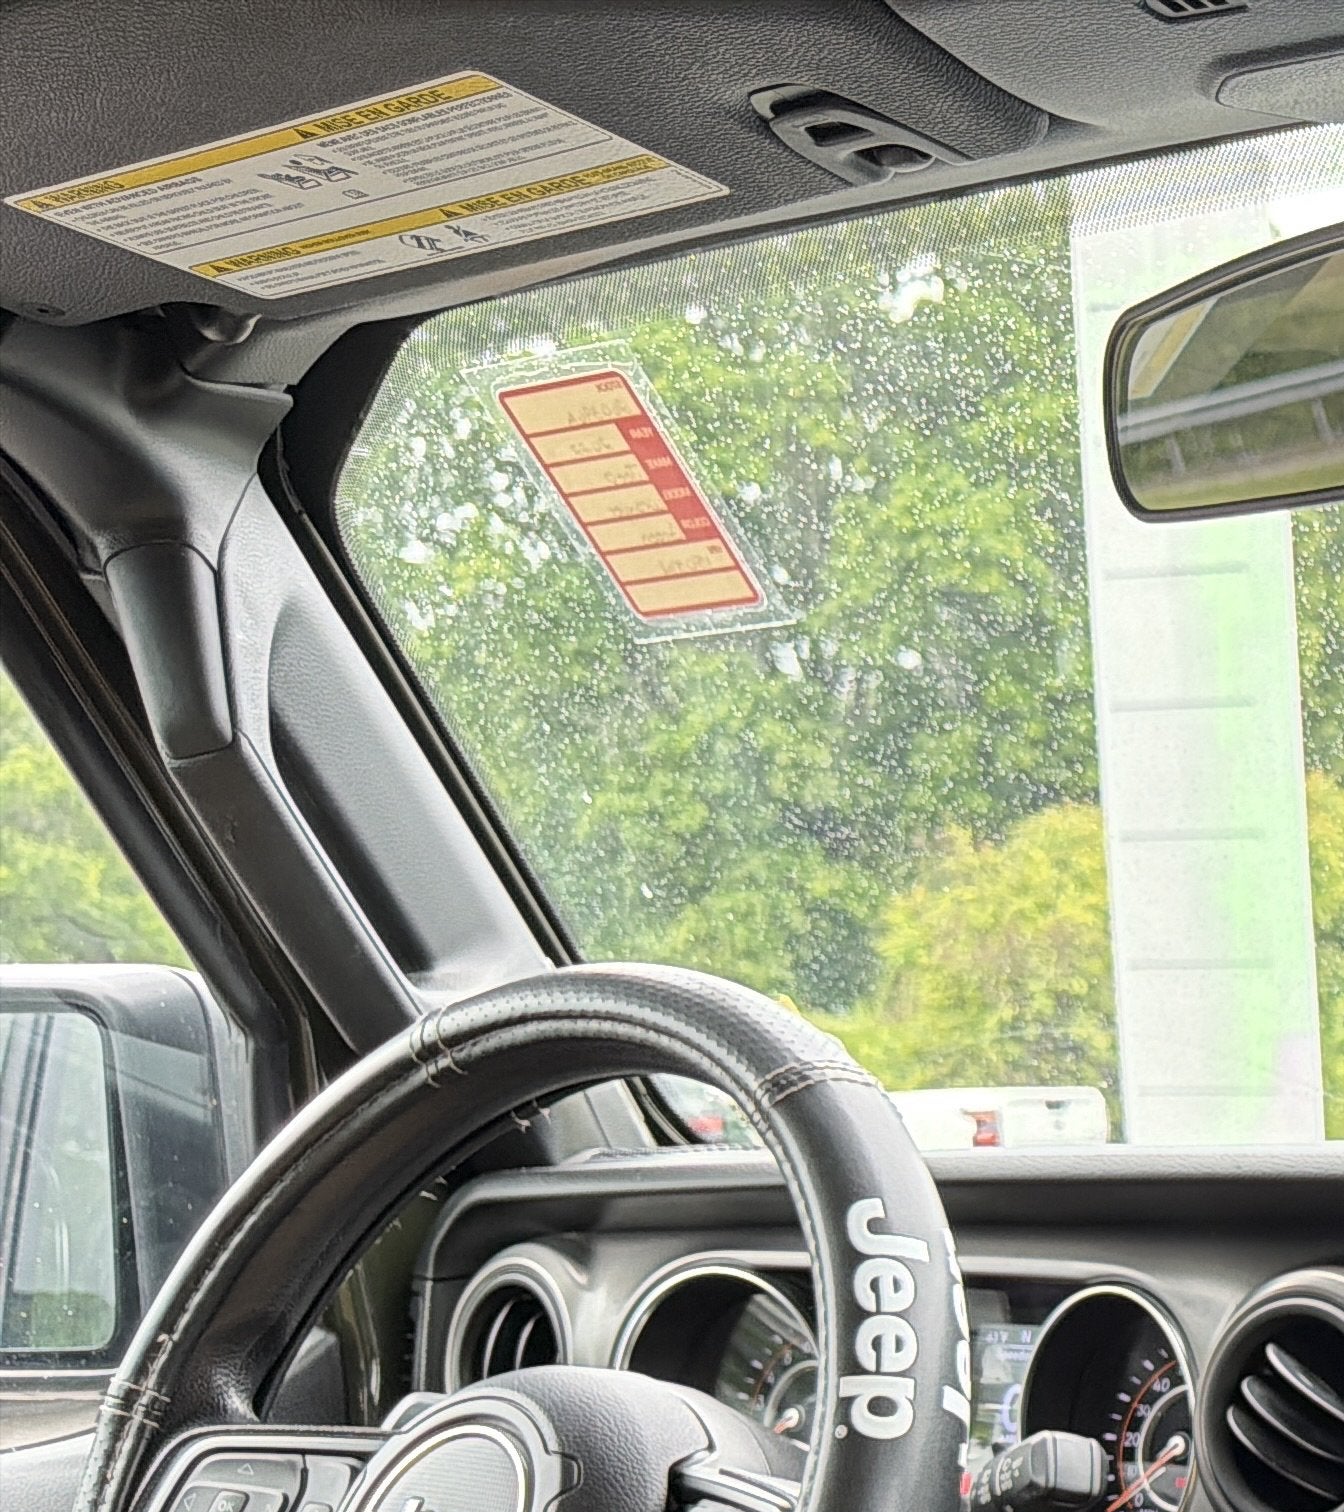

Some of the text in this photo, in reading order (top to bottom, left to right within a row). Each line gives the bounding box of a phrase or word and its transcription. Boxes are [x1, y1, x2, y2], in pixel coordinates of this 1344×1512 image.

[313, 114, 364, 132] MISE
[355, 107, 390, 121] EN
[384, 89, 453, 113] GARDE
[46, 180, 125, 204] WARNING
[459, 174, 593, 213] MISE EN GARDE
[225, 246, 301, 268] WARNING
[1152, 1377, 1171, 1393] 40
[1124, 1431, 1141, 1448] 20
